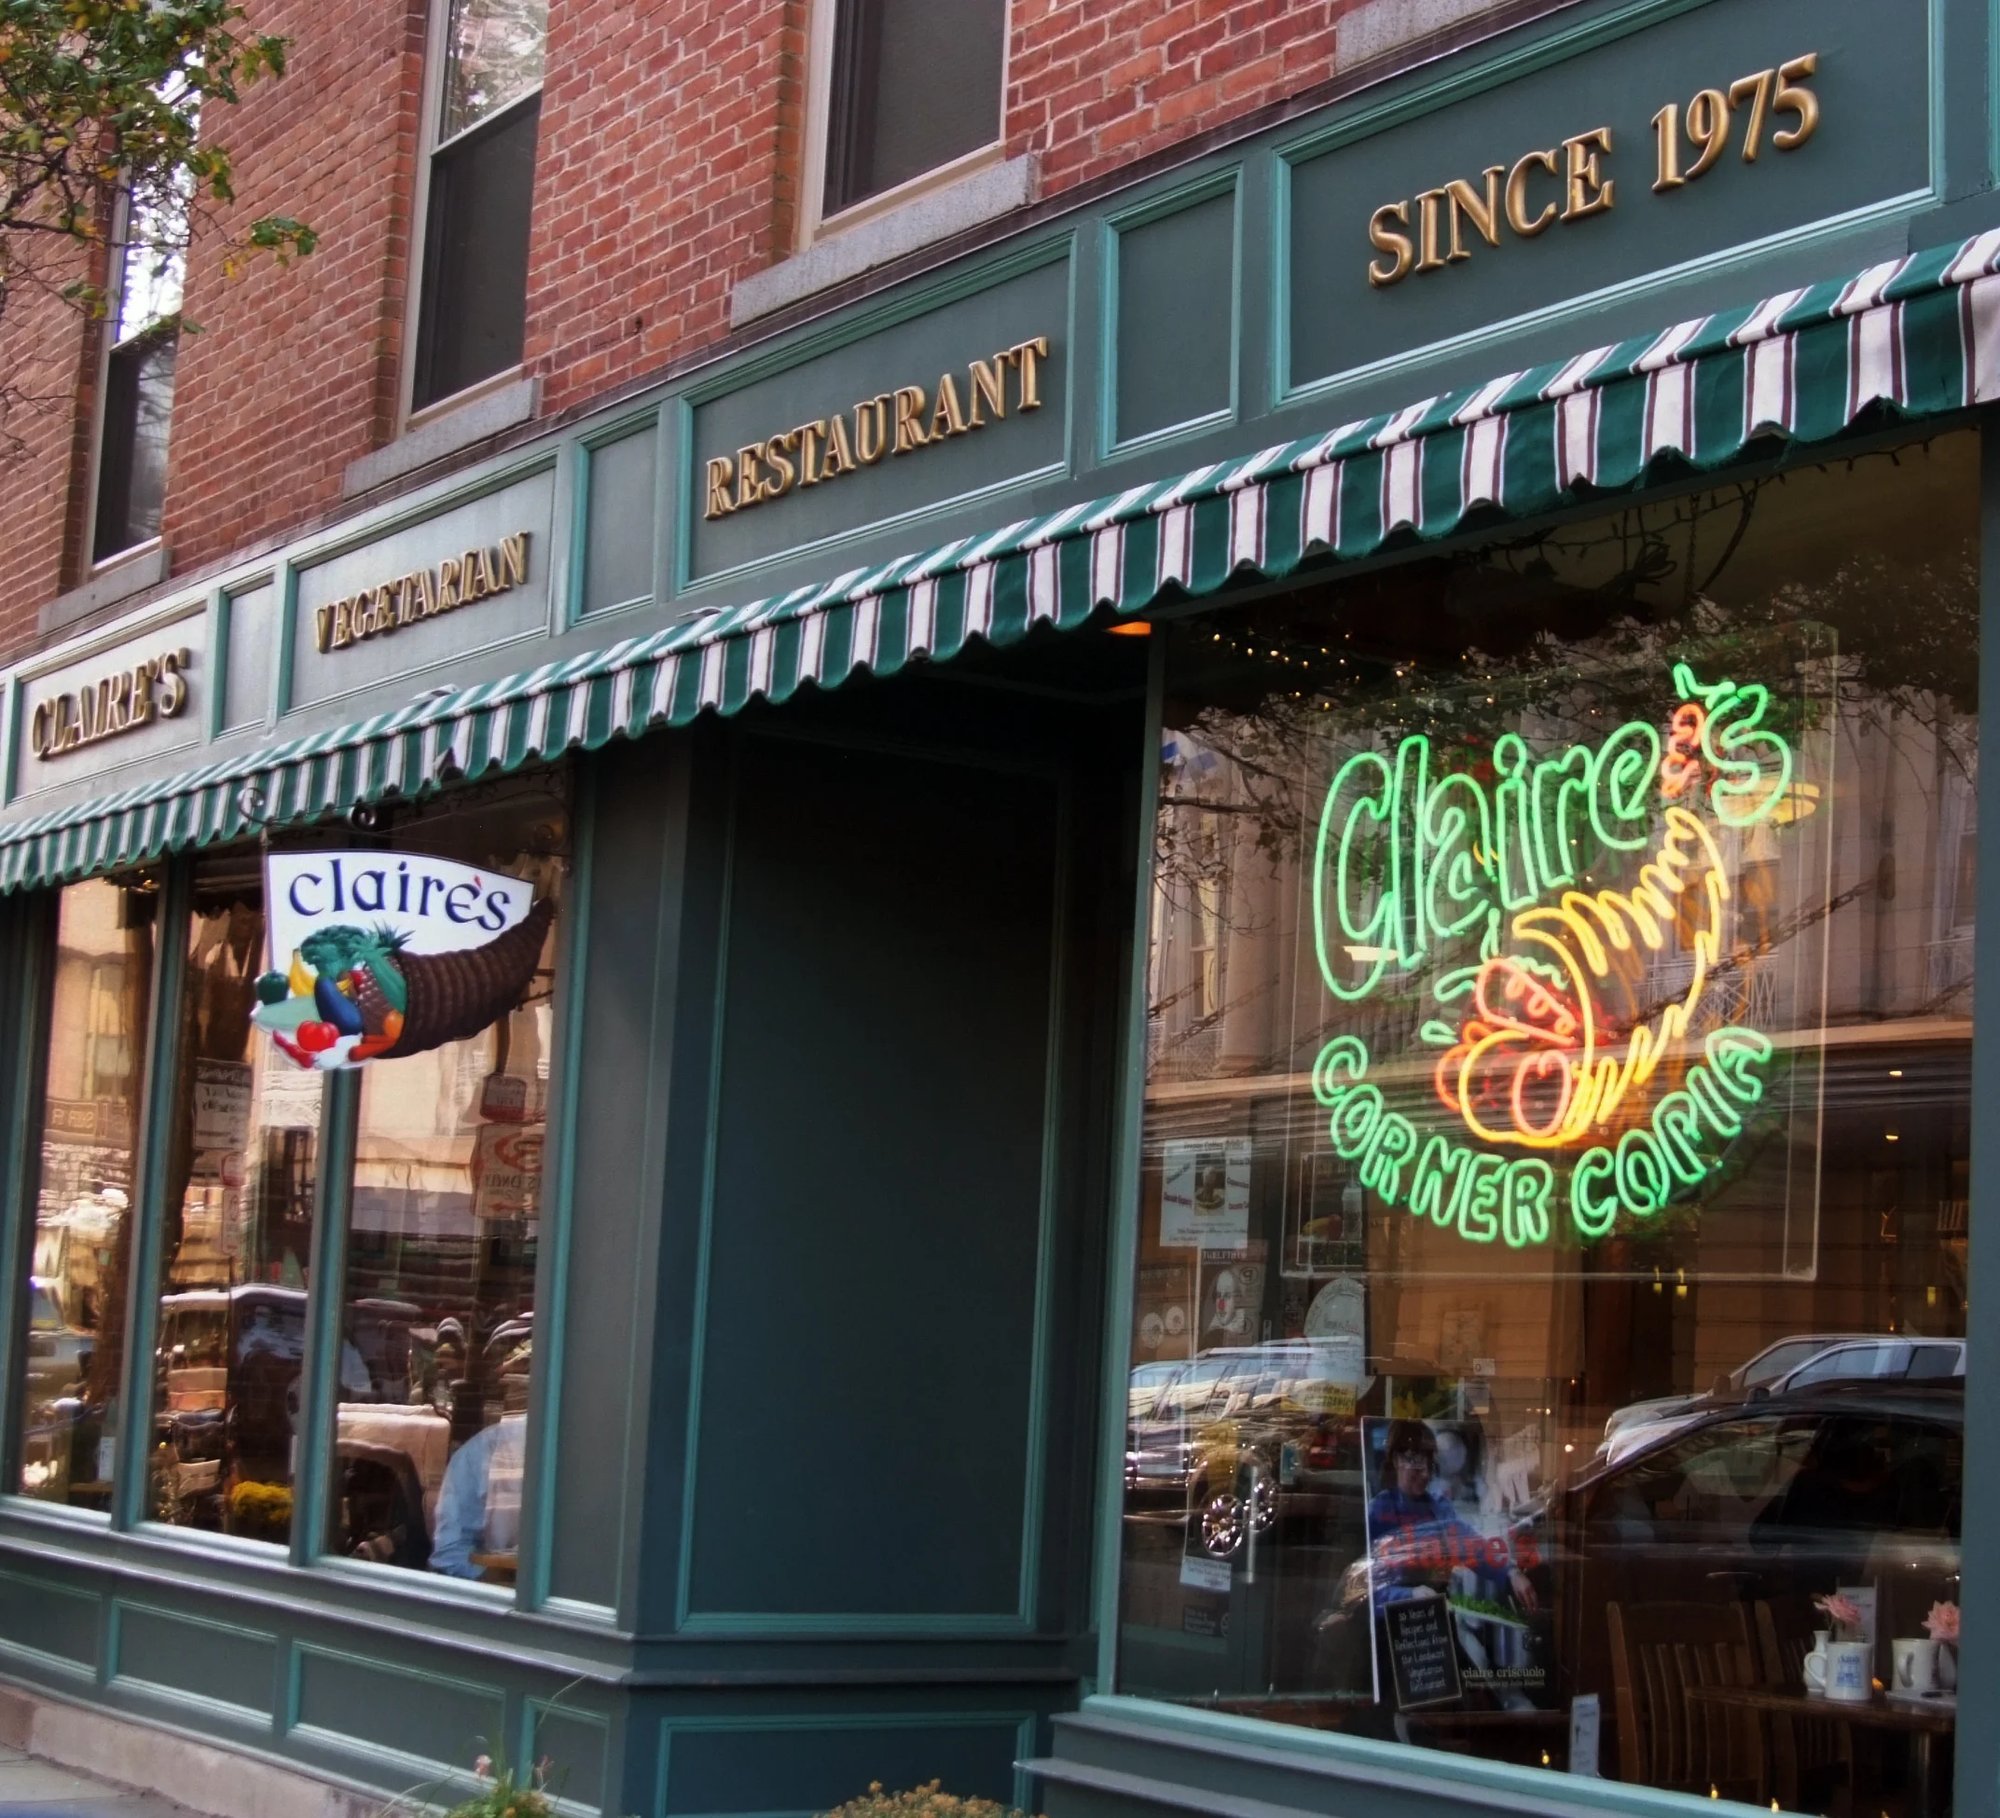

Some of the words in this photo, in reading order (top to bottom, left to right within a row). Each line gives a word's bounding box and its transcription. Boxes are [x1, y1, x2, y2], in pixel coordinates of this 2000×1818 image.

[1368, 127, 1615, 287] SINCE
[1650, 52, 1820, 192] 1975
[703, 336, 1048, 521] RESTAURANT
[313, 531, 530, 653] VEGETARIAN
[32, 646, 190, 761] CLAIRE'S
[288, 858, 512, 932] claire's
[1311, 1034, 1553, 1248] CORNER
[1569, 1025, 1774, 1237] COPIA
[1463, 1667, 1494, 1678] claire
[1496, 1666, 1545, 1678] criscuolo
